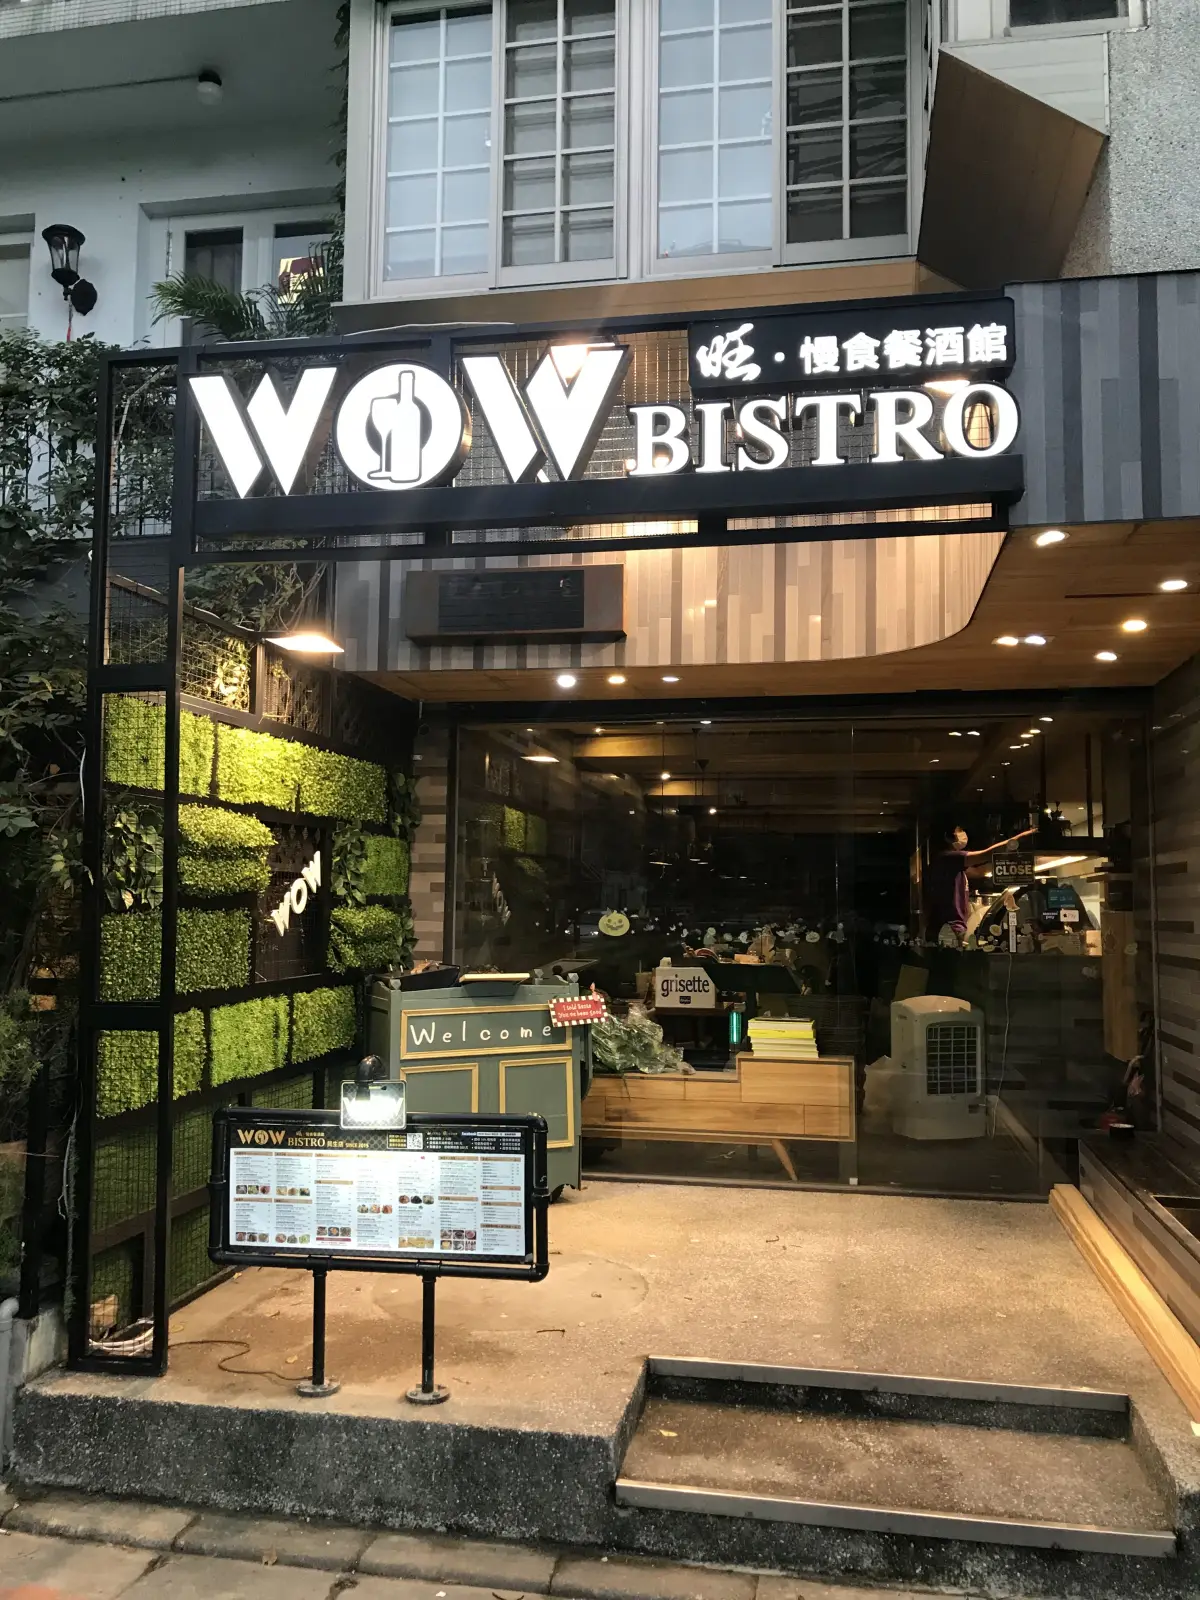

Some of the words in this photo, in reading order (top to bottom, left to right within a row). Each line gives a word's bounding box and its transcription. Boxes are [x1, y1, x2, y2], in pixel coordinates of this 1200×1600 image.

[189, 346, 624, 499] WOW
[628, 383, 1019, 476] BISTRO
[995, 864, 1033, 876] CLOSE
[271, 850, 322, 937] WOW
[661, 973, 710, 997] grisette
[409, 1020, 552, 1046] Welcome
[237, 1129, 286, 1145] WOW
[287, 1137, 326, 1147] BISTRO
